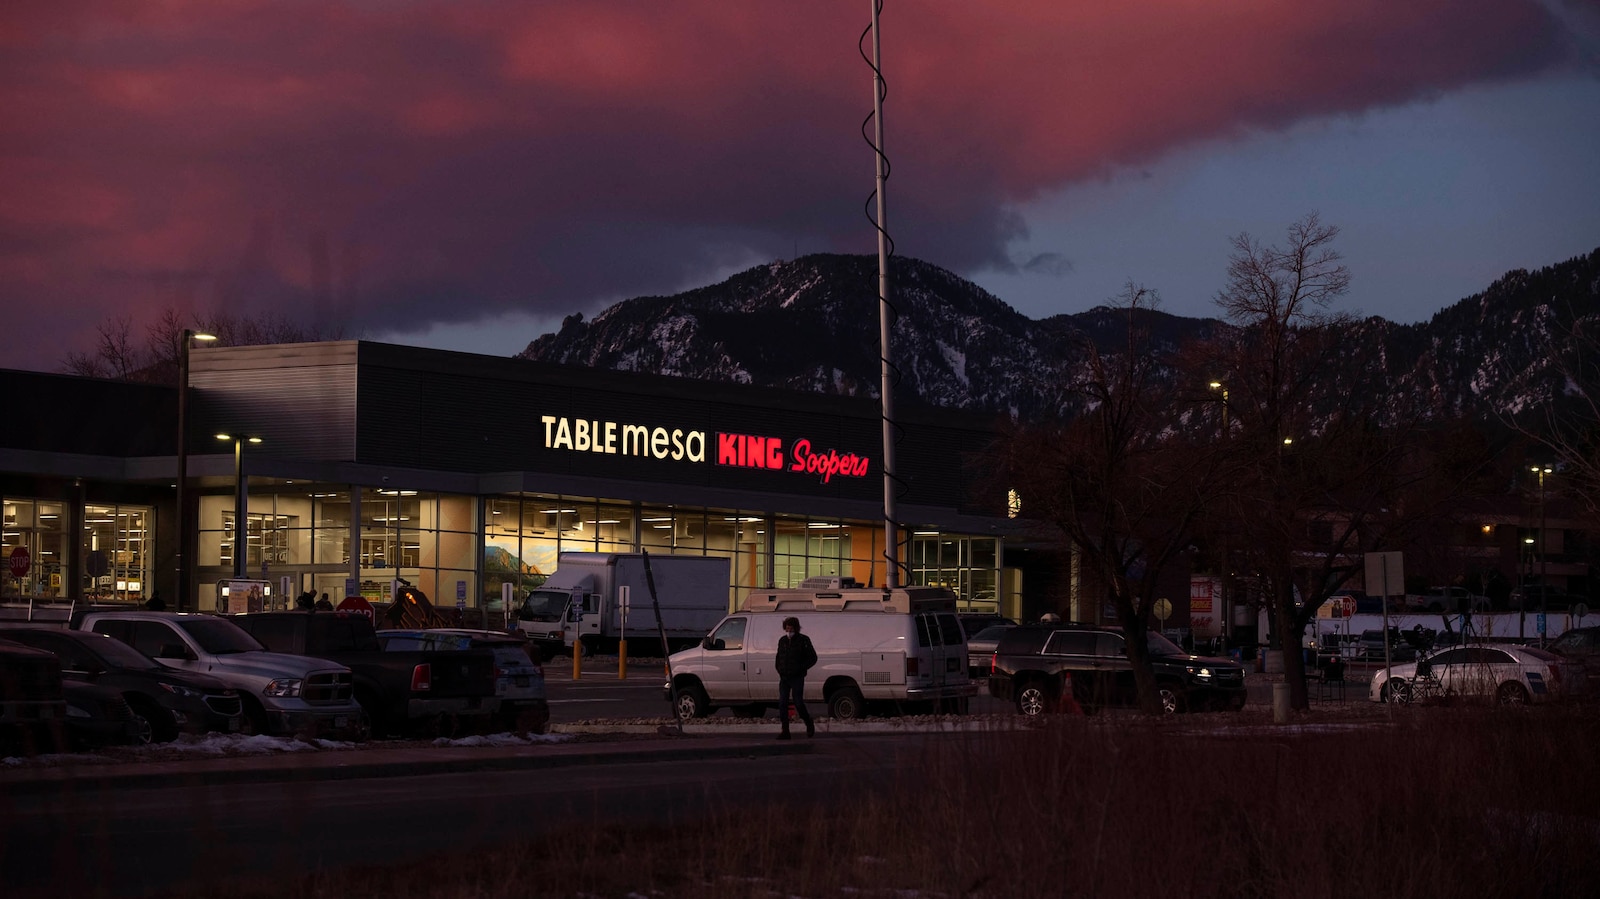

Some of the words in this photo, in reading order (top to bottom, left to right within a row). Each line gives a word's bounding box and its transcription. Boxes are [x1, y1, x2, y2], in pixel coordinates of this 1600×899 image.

[541, 415, 617, 454] TABLE
[622, 424, 705, 462] mesa
[717, 432, 783, 470] KING
[789, 438, 869, 484] Soopers
[10, 556, 30, 569] STOP
